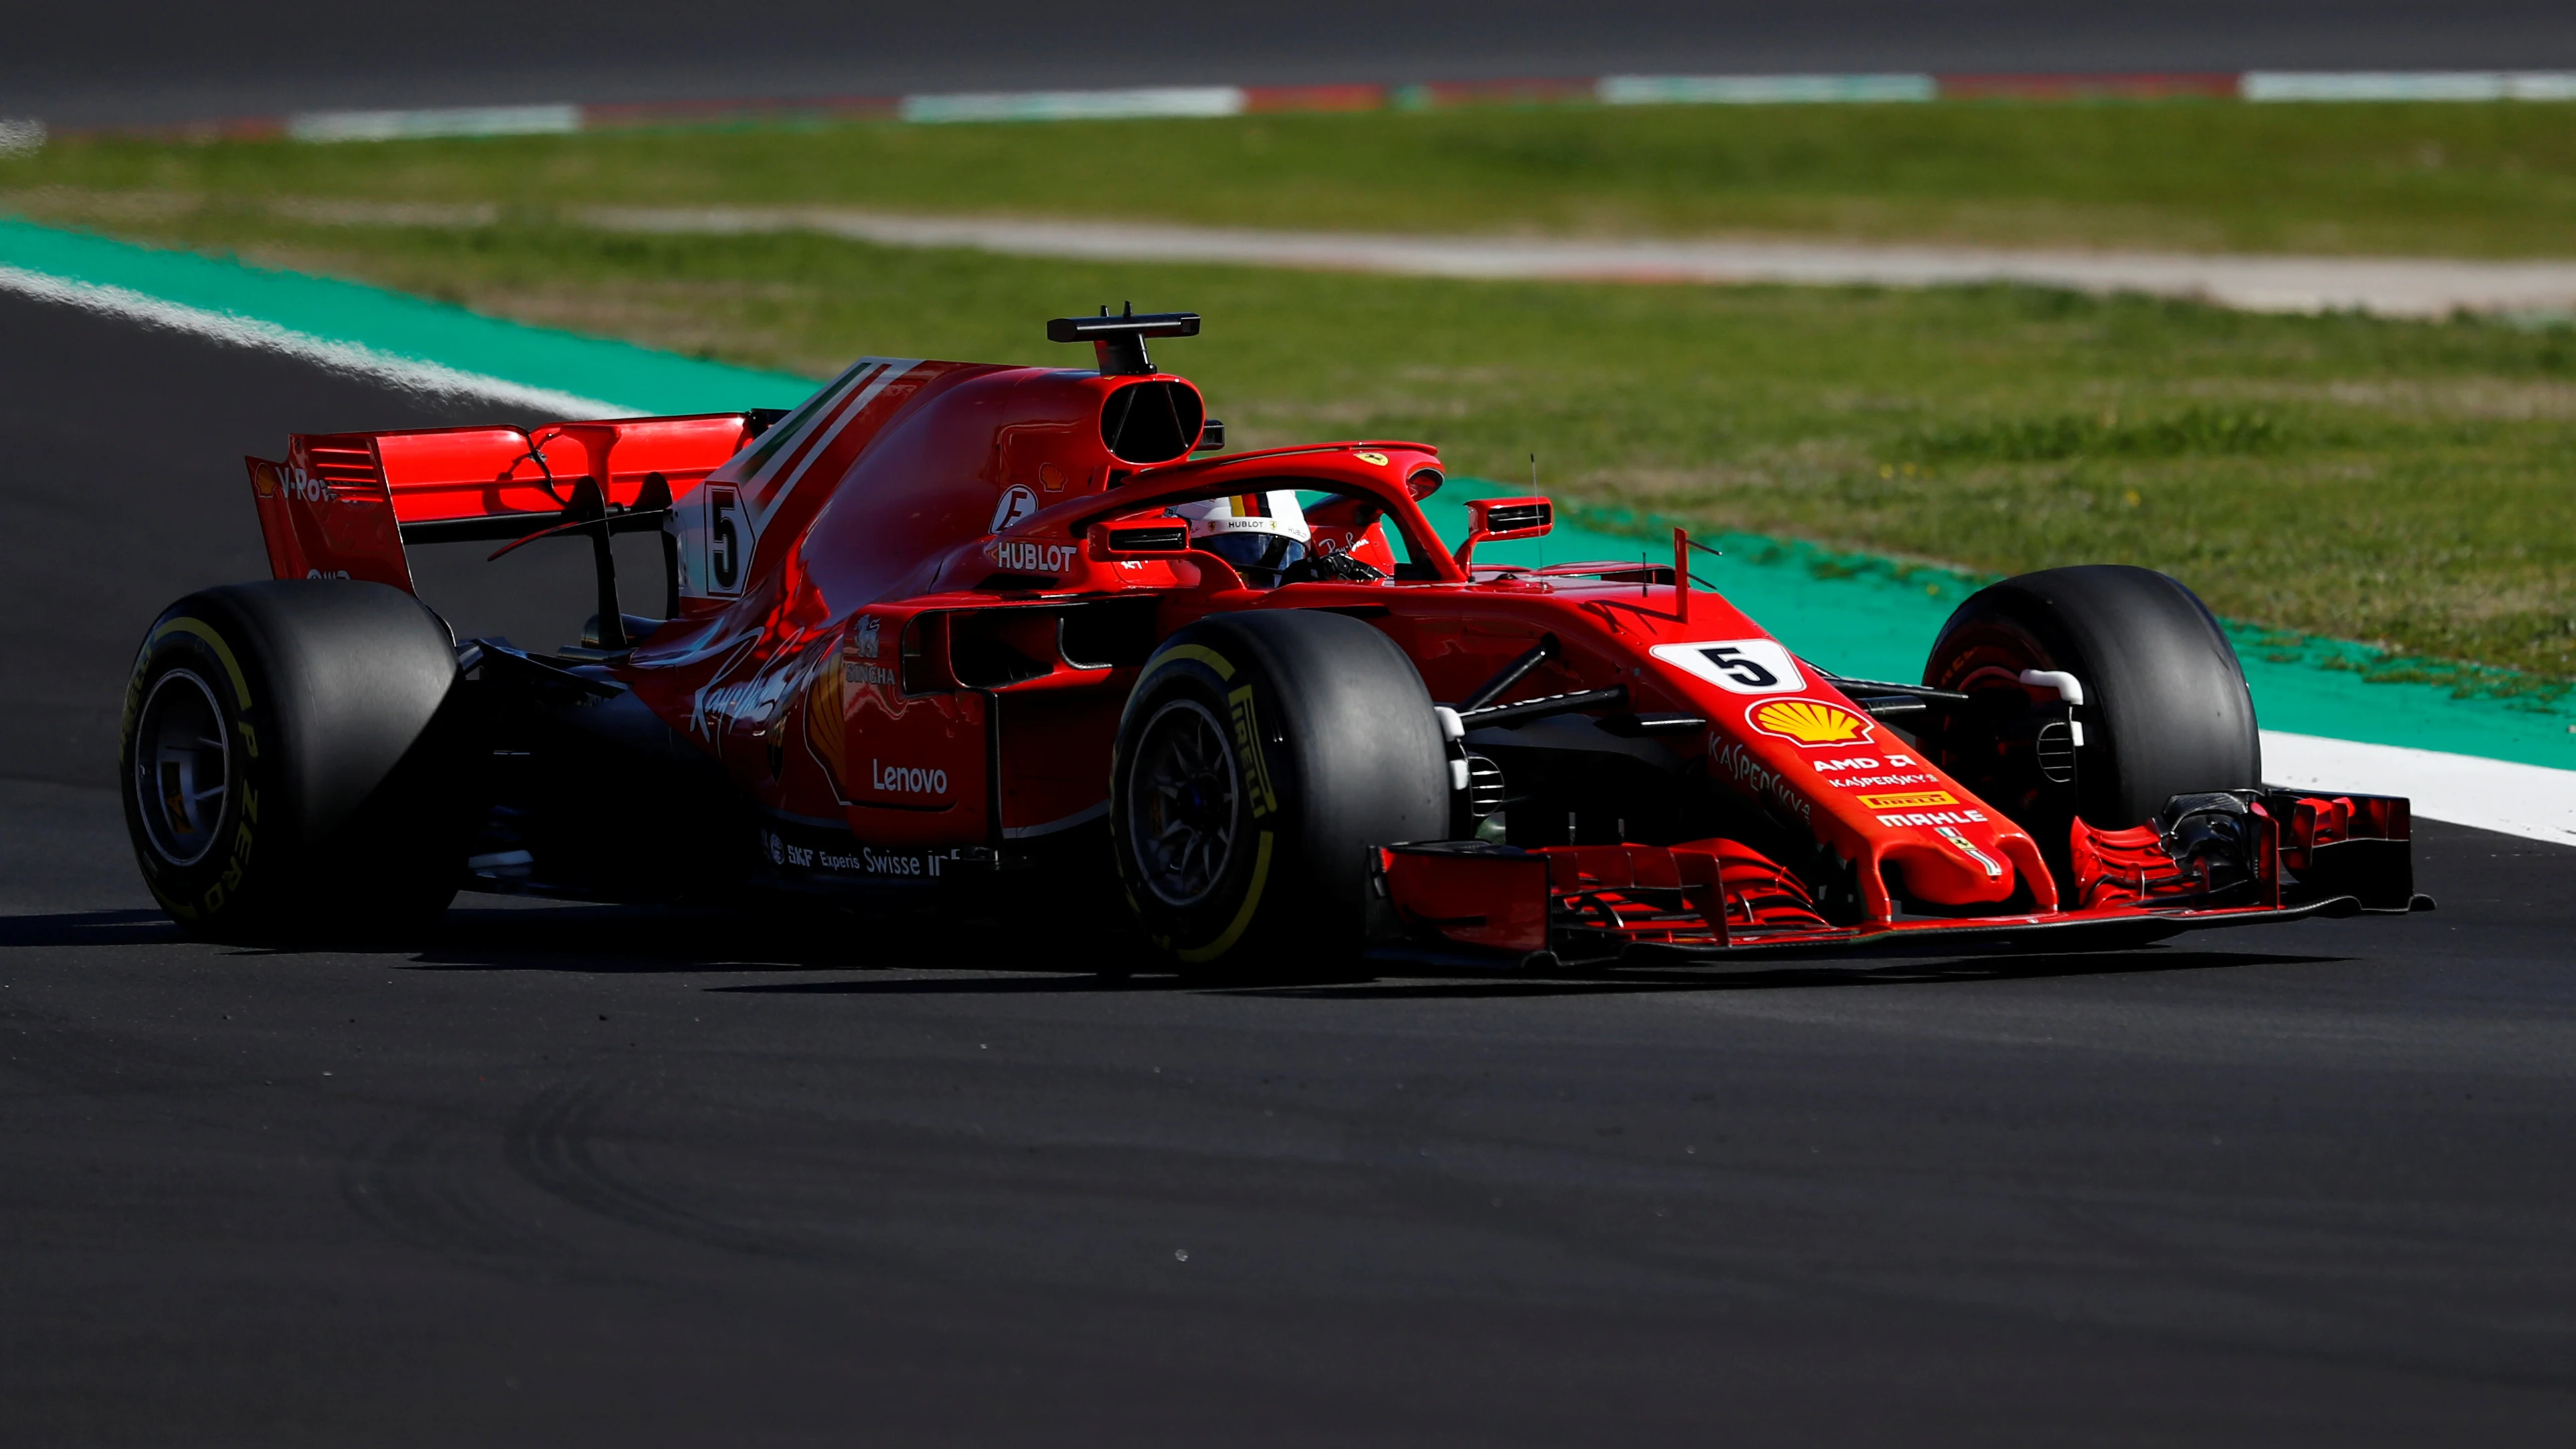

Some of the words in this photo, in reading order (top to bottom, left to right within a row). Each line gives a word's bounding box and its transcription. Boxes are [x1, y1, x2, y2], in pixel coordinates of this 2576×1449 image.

[712, 489, 738, 589] 5
[998, 542, 1078, 572] HUBLOT
[846, 664, 896, 686] SINGHA
[1699, 648, 1777, 686] 5
[238, 720, 258, 759] P
[1228, 683, 1278, 820] PIRELLI
[873, 758, 947, 795] Lenovo
[1813, 757, 1880, 773] AMD
[1828, 774, 1926, 788] KASPERSKY
[1867, 793, 1946, 806] PIRELLI
[1876, 809, 1988, 828] MAHLE
[204, 777, 259, 915] ZERO
[787, 844, 813, 867] SKF
[819, 850, 861, 871] Experis
[863, 846, 921, 876] Swisse
